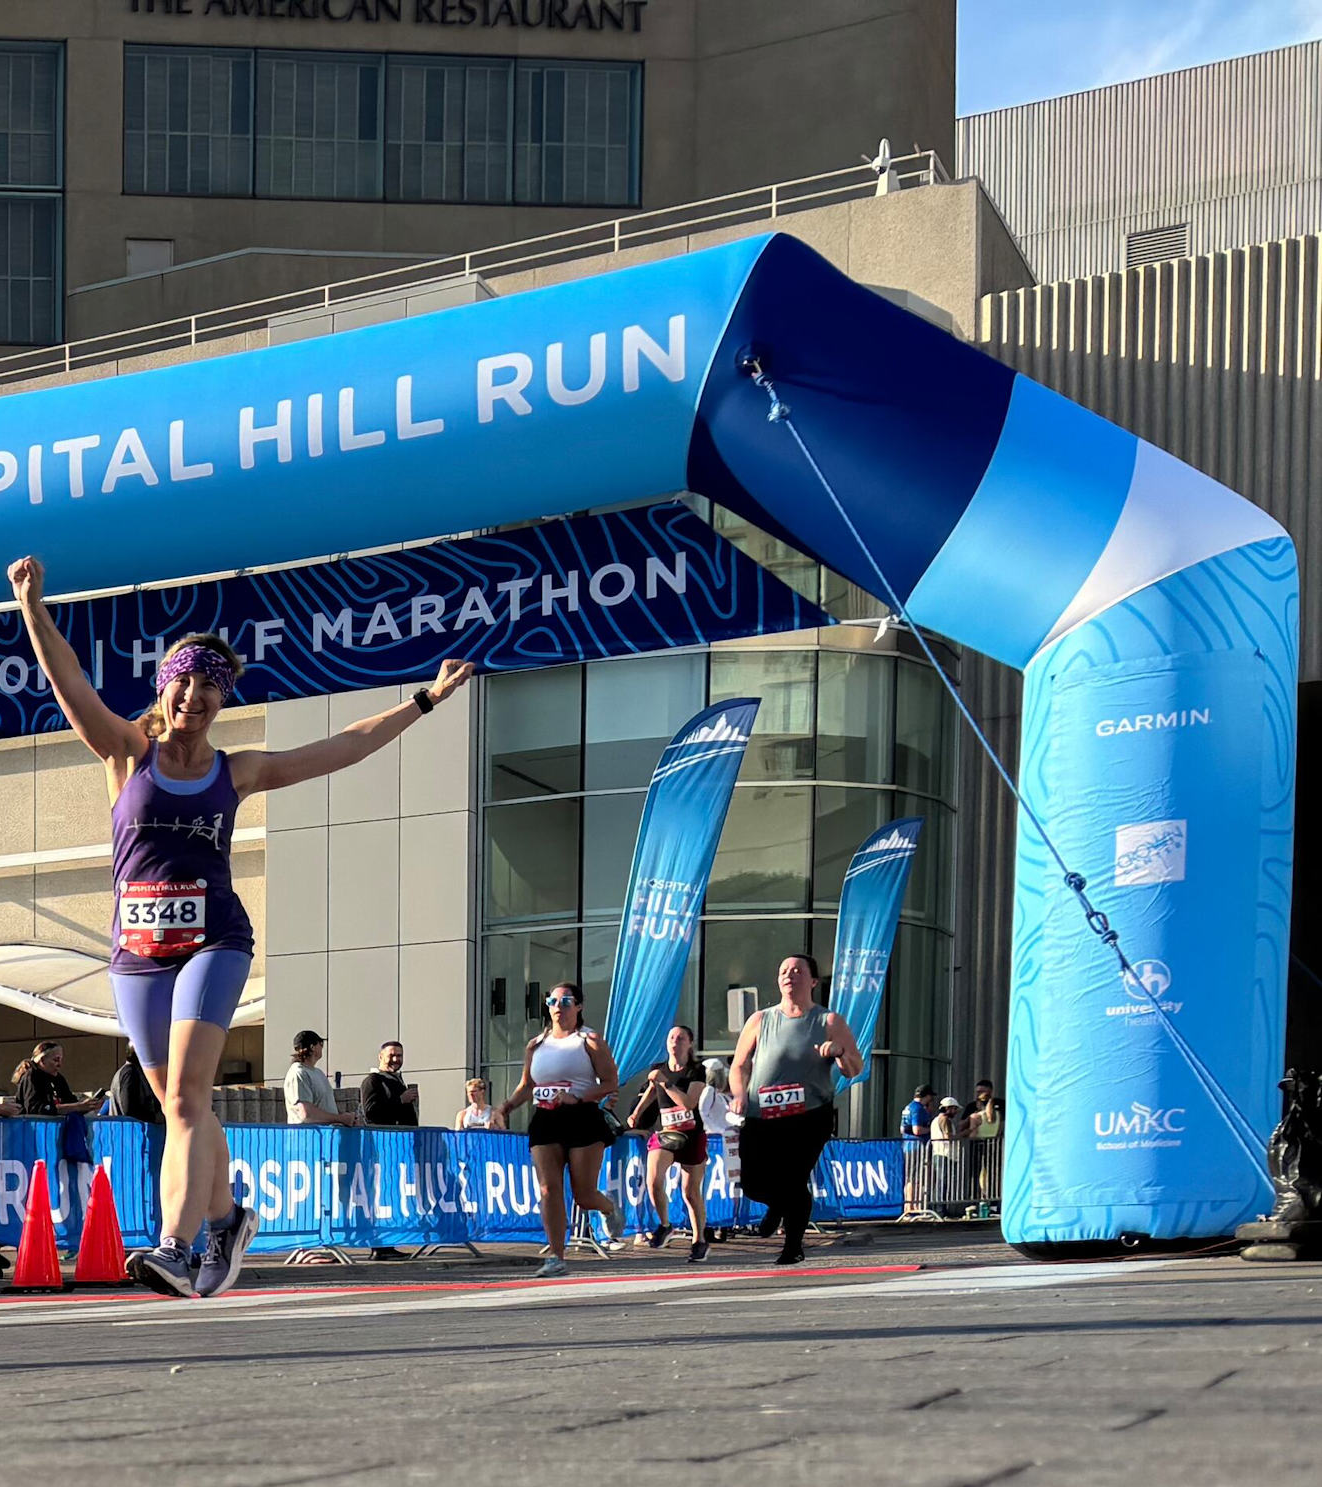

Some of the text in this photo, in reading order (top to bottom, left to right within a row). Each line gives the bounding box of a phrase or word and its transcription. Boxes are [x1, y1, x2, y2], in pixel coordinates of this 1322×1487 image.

[415, 0, 649, 32] RESTAURANT
[238, 374, 445, 470] HILL
[476, 313, 687, 424] RUN
[132, 618, 286, 679] HLF
[312, 551, 688, 653] MARATHON
[1095, 707, 1211, 737] GARMIN
[126, 900, 198, 924] 3348
[633, 889, 692, 917] HILL
[628, 914, 693, 943] RUN
[836, 974, 884, 993] RUN
[764, 1090, 800, 1105] 4071
[1094, 1103, 1186, 1137] UMKC
[229, 1158, 393, 1221] OSPITAL
[398, 1160, 478, 1218] HILL
[830, 1159, 889, 1199] RUN
